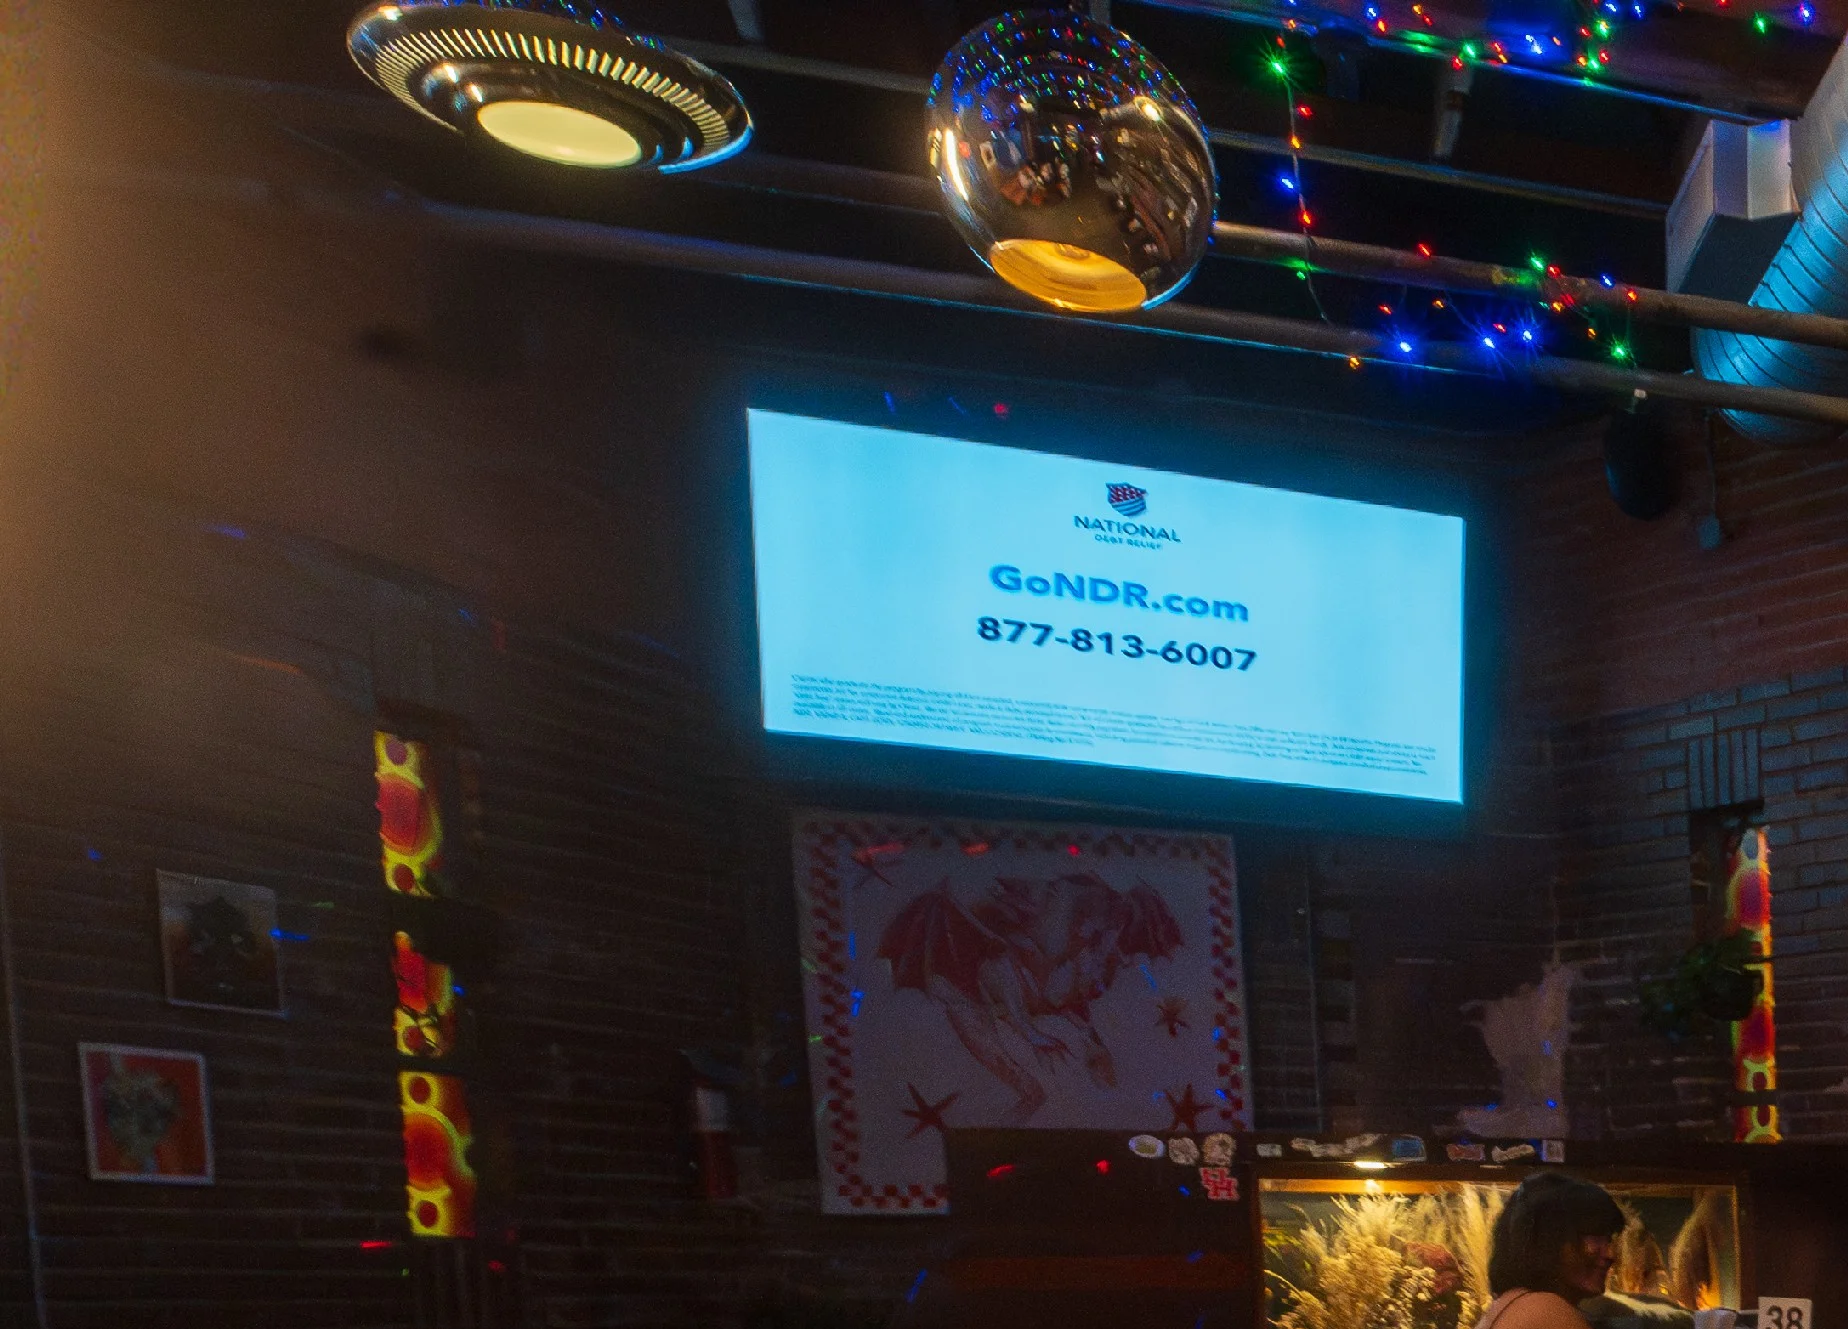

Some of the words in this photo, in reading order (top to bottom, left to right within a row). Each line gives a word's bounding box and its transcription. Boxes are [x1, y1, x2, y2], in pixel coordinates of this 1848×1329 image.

[1073, 515, 1182, 543] NATIONAL
[1126, 538, 1161, 550] RELIEF
[989, 564, 1249, 622] GoNDR.com
[977, 616, 1257, 671] 877-813-6007
